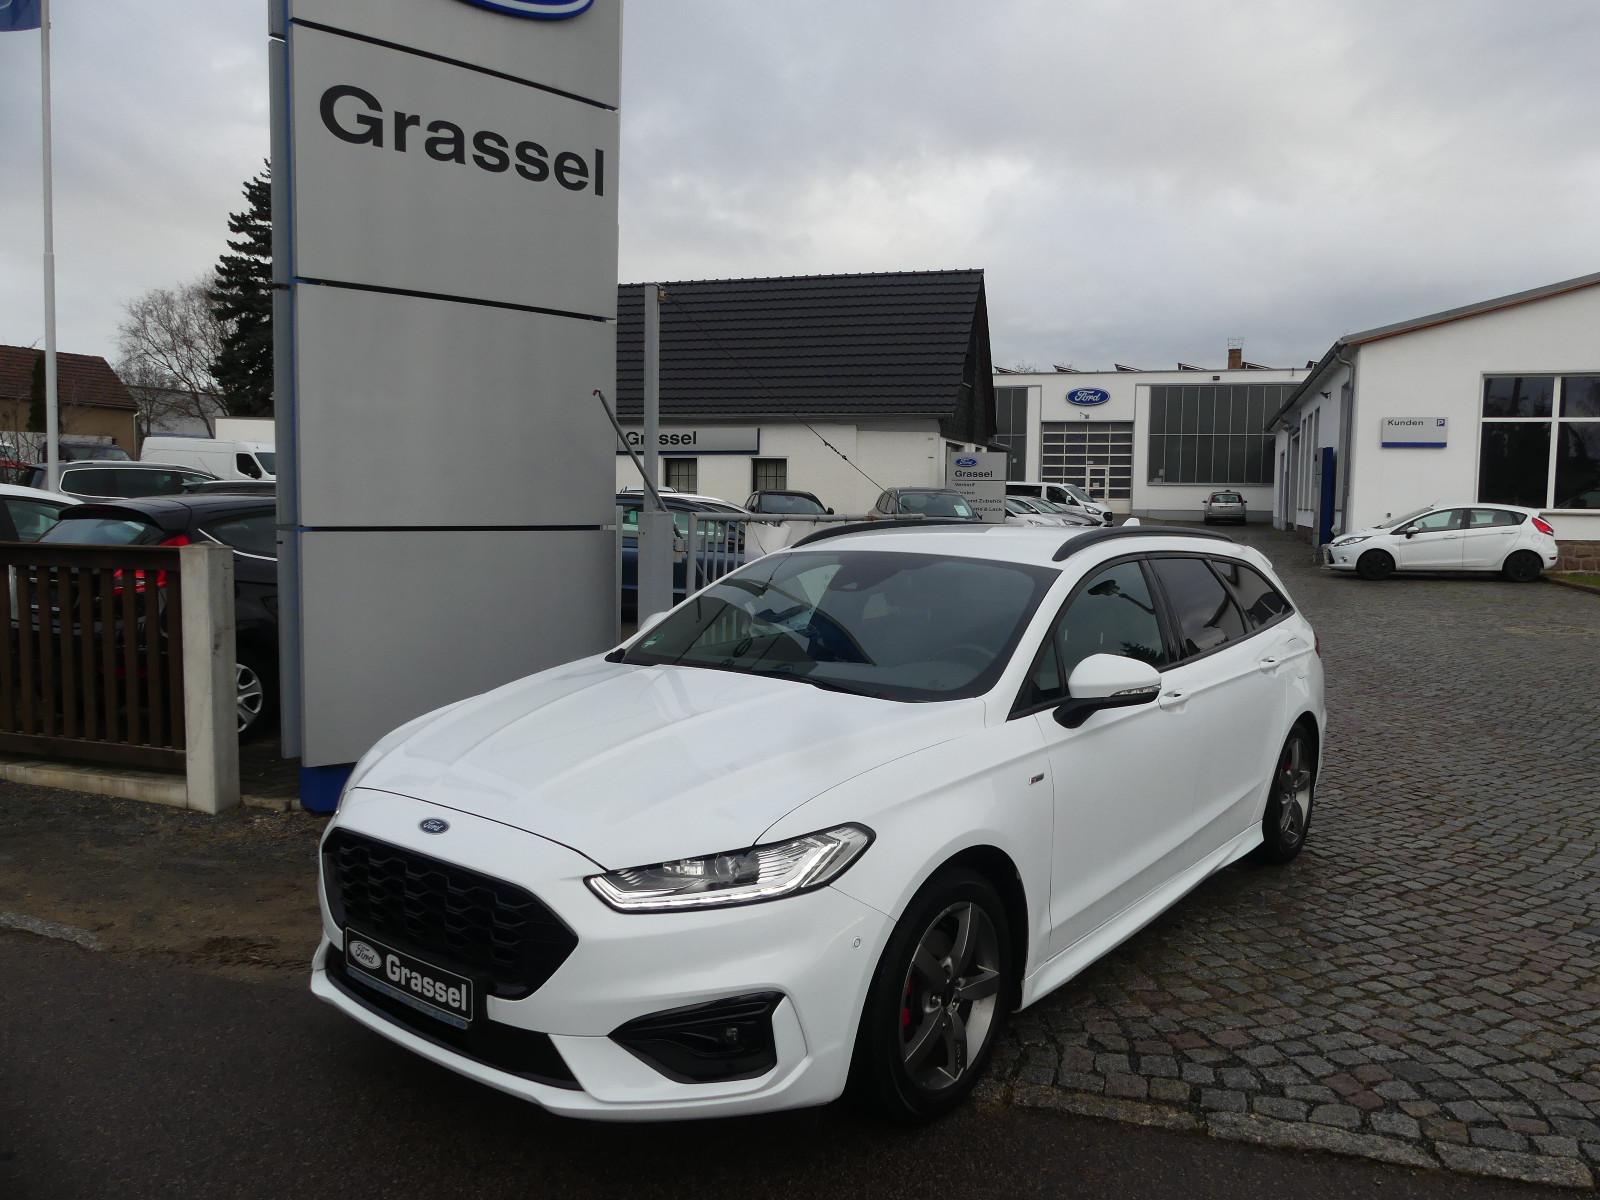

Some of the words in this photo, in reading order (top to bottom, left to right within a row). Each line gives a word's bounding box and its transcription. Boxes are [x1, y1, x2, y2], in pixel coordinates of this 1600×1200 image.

[319, 84, 604, 197] Grassel
[625, 430, 697, 446] Grssel
[954, 470, 993, 478] Grassel
[386, 953, 467, 1012] Grassel
